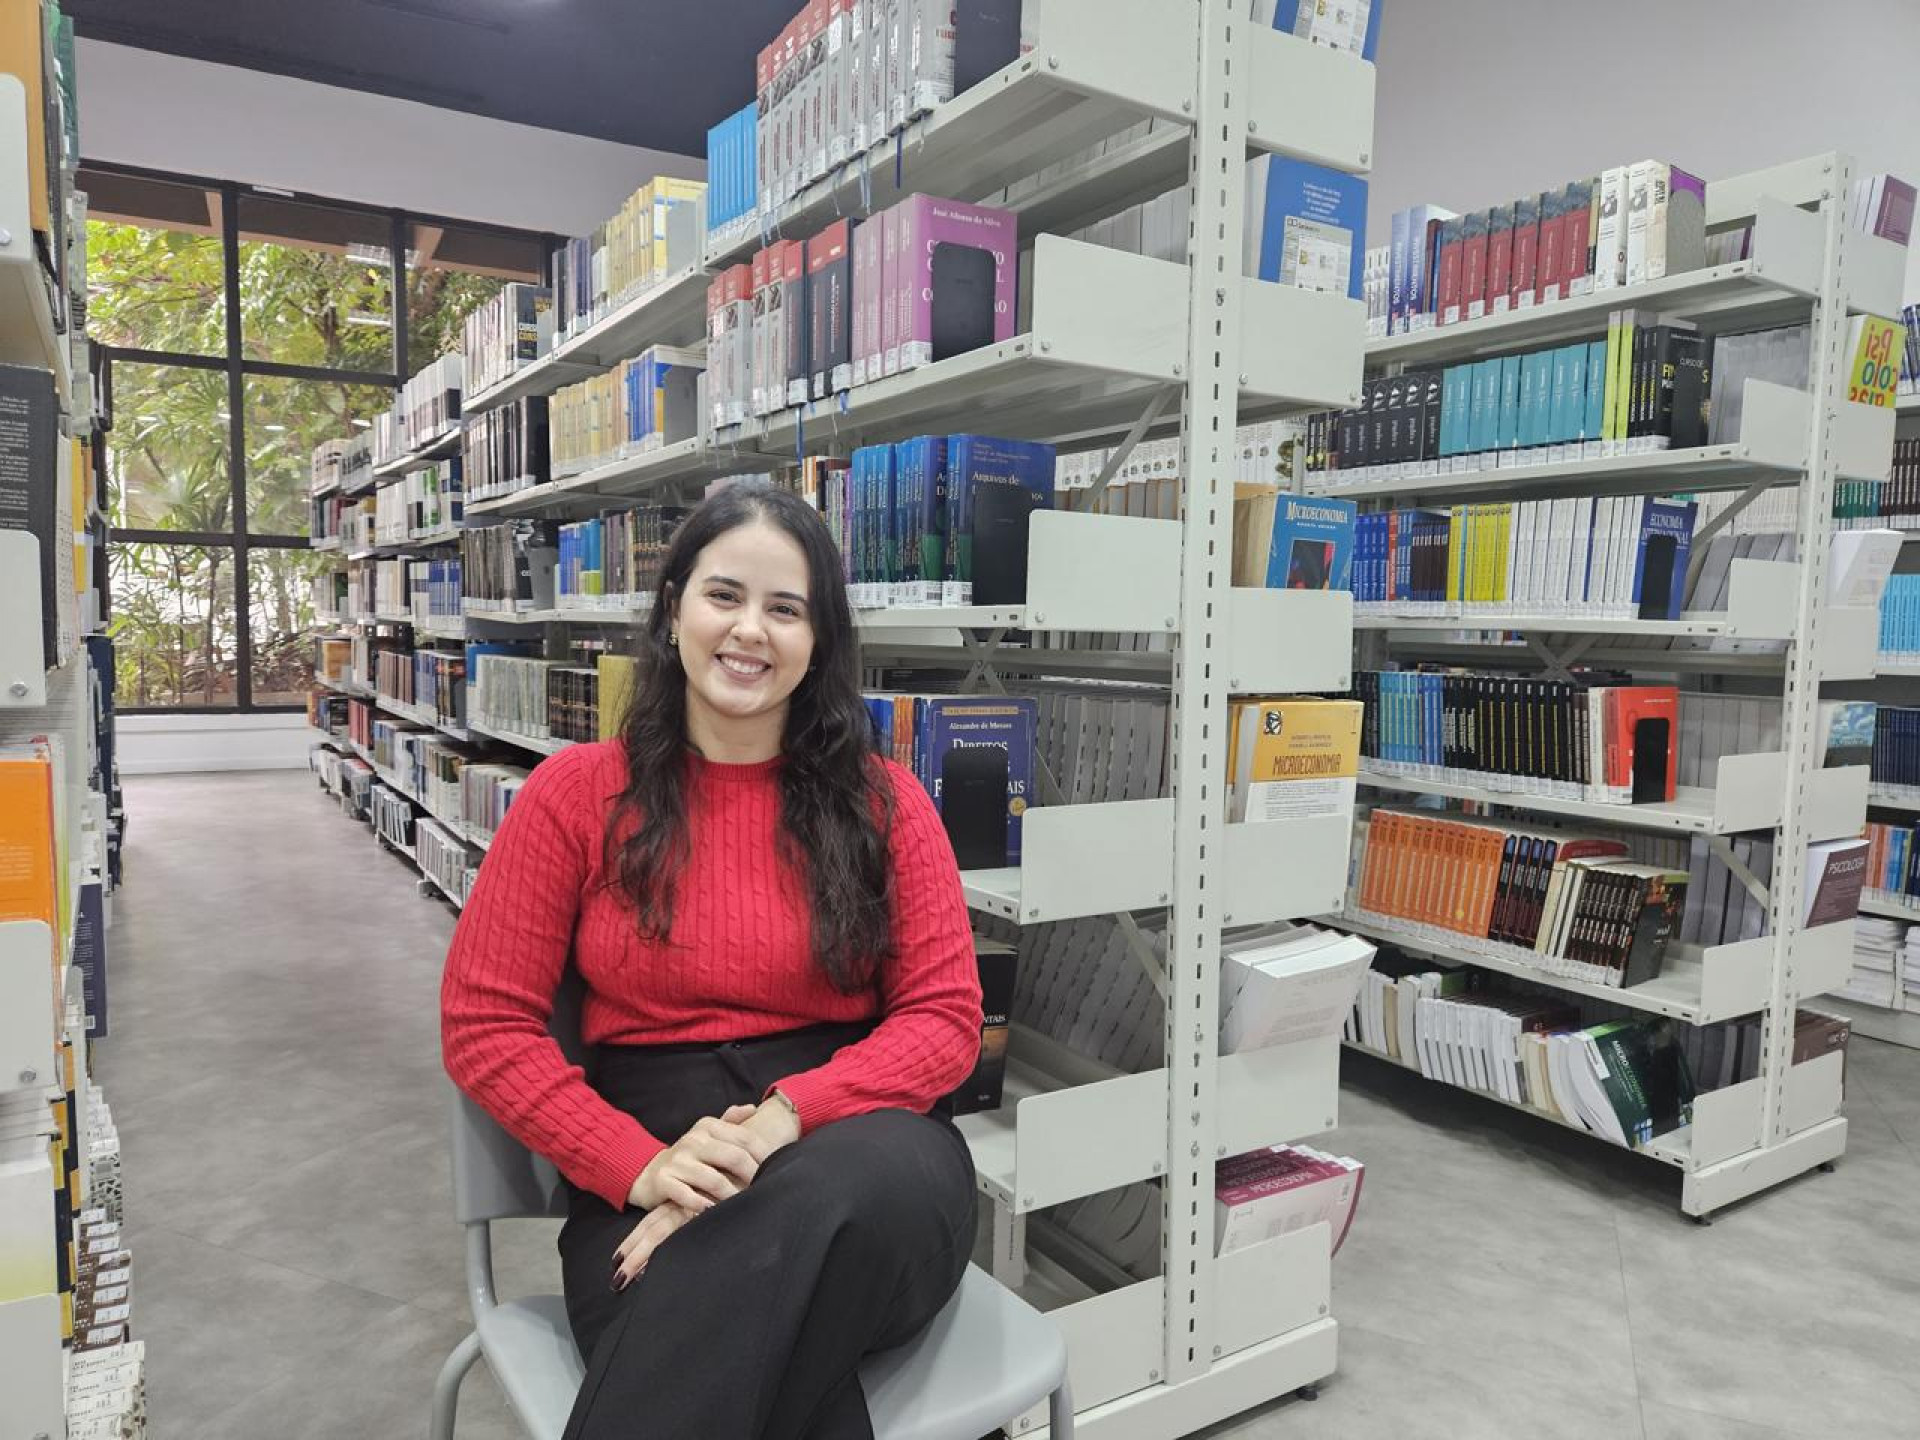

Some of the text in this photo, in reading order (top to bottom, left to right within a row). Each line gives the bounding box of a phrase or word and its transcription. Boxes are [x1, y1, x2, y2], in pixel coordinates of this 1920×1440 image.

[971, 471, 1020, 486] Arquivos de
[1284, 501, 1348, 524] MICROECONOMIA
[1650, 512, 1684, 528] ECONOMIA
[949, 722, 979, 730] Alexandre
[981, 722, 988, 730] de
[1272, 754, 1342, 777] MICROECONOMIA
